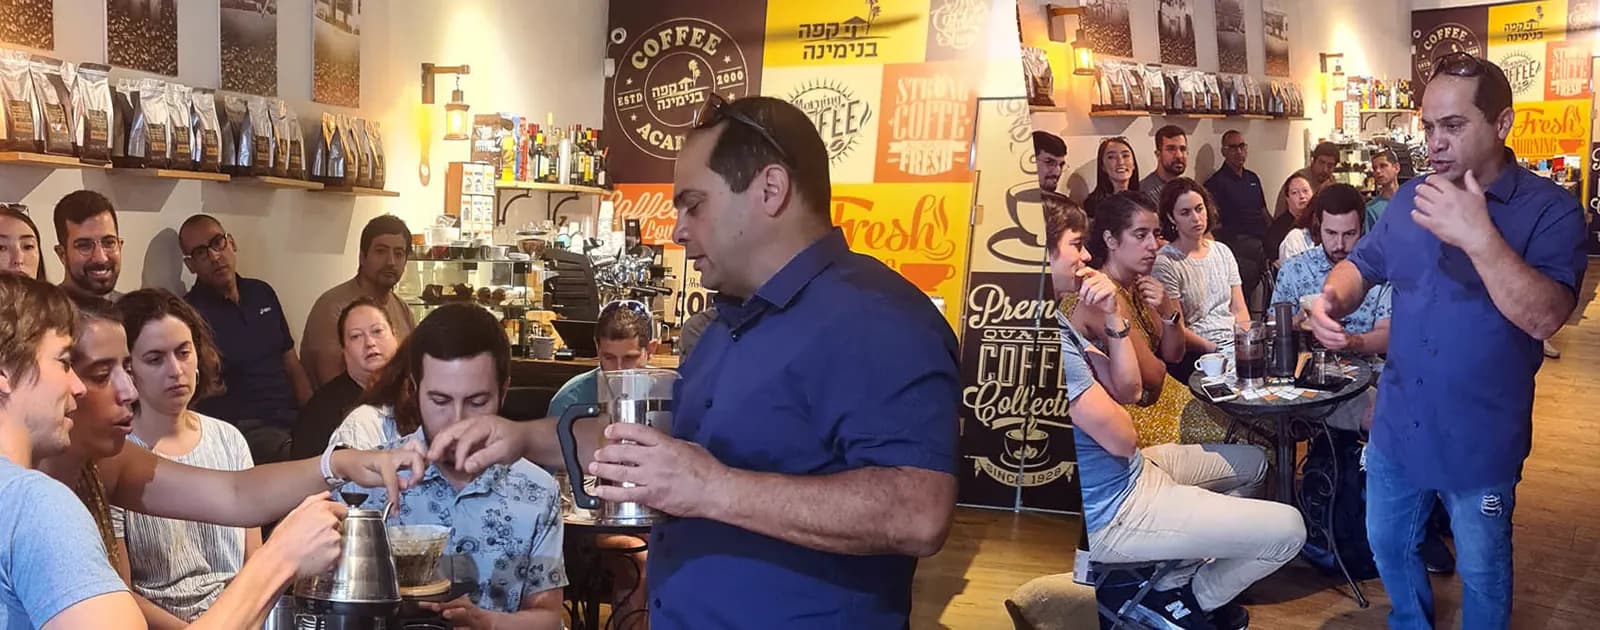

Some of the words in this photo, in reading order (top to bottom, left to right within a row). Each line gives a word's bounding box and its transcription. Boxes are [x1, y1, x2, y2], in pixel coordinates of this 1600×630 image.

[798, 22, 839, 40] קפה
[1424, 27, 1468, 50] COFFEE
[631, 26, 722, 69] COFFEE
[803, 42, 878, 60] בנימינה
[716, 70, 744, 86] 2000
[617, 93, 643, 106] ESTD
[651, 83, 678, 98] קפה
[657, 91, 705, 111] בנימינה
[893, 101, 967, 139] COFFE
[1512, 105, 1585, 137] Fresh
[968, 283, 1058, 329] Prem
[983, 329, 1061, 341] QUALI
[963, 380, 1070, 428] Collecti
[1031, 467, 1062, 485] 1928
